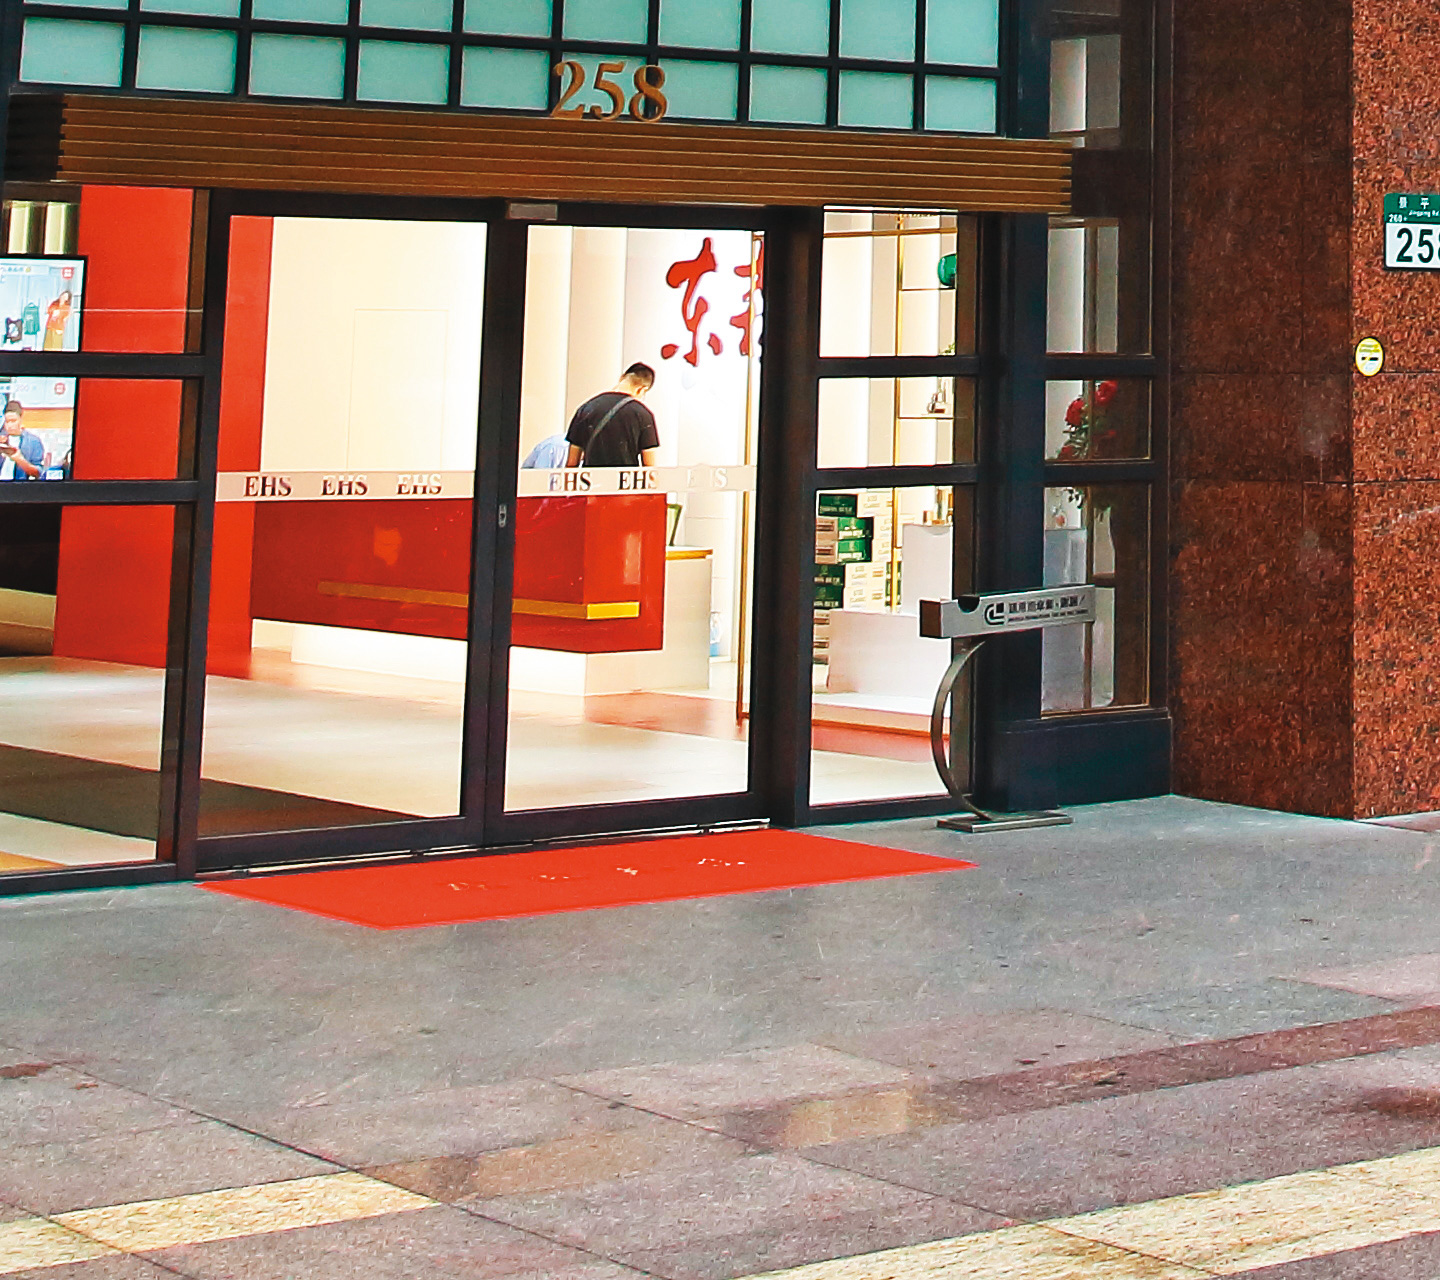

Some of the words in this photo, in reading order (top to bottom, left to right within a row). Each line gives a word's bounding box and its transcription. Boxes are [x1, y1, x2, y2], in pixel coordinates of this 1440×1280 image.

[550, 60, 668, 123] 258
[243, 475, 293, 498] EHS
[320, 473, 369, 497] EHS
[395, 472, 443, 496] EHS
[548, 470, 592, 492] EHS
[618, 470, 659, 491] EHS
